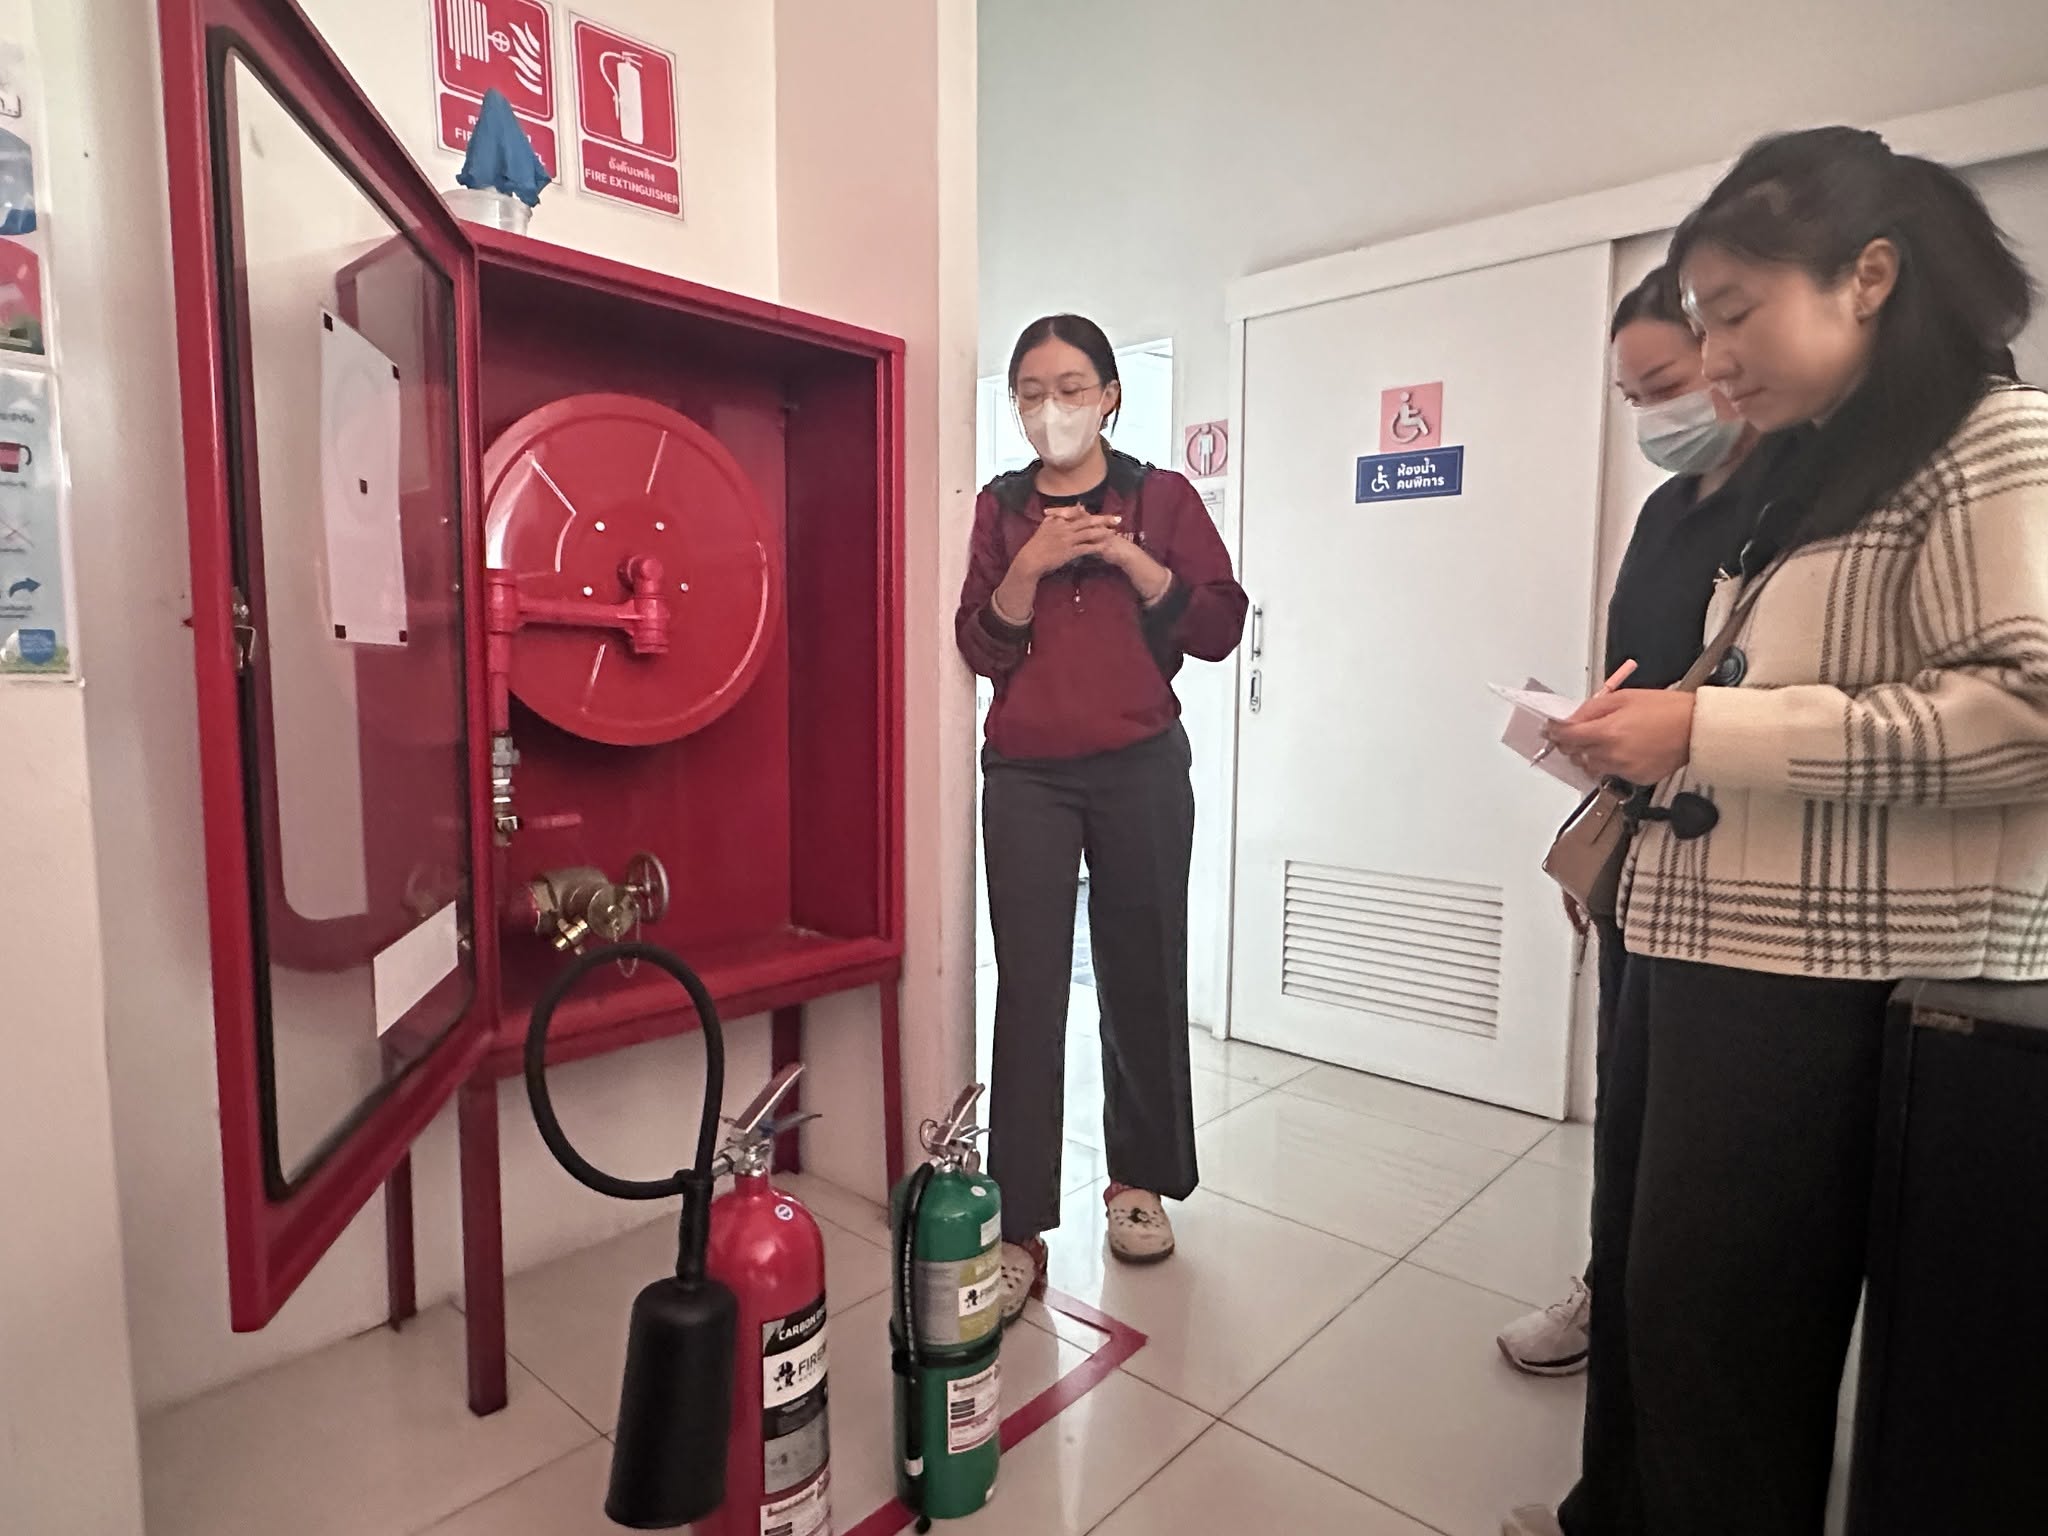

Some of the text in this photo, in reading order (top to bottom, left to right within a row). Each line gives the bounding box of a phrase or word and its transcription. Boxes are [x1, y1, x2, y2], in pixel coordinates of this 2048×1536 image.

[585, 168, 678, 204] FIRE EXTINGUISHER
[1397, 457, 1436, 476] ห้องน้ำ
[779, 1314, 816, 1341] CARBON
